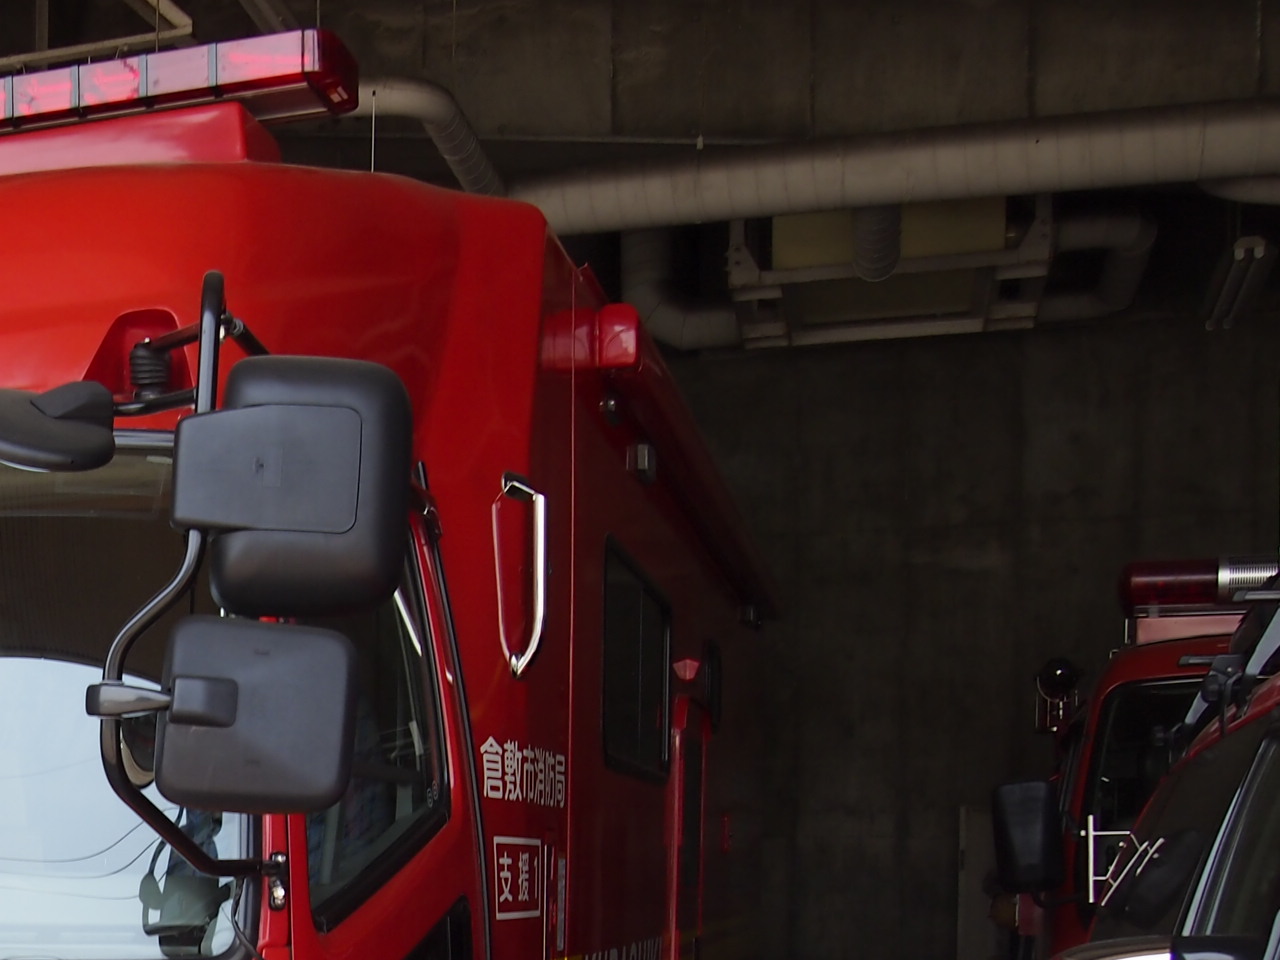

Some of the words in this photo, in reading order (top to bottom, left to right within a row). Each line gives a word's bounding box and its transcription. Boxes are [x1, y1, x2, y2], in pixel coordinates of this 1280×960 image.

[480, 735, 566, 809] 倉敷市消防局
